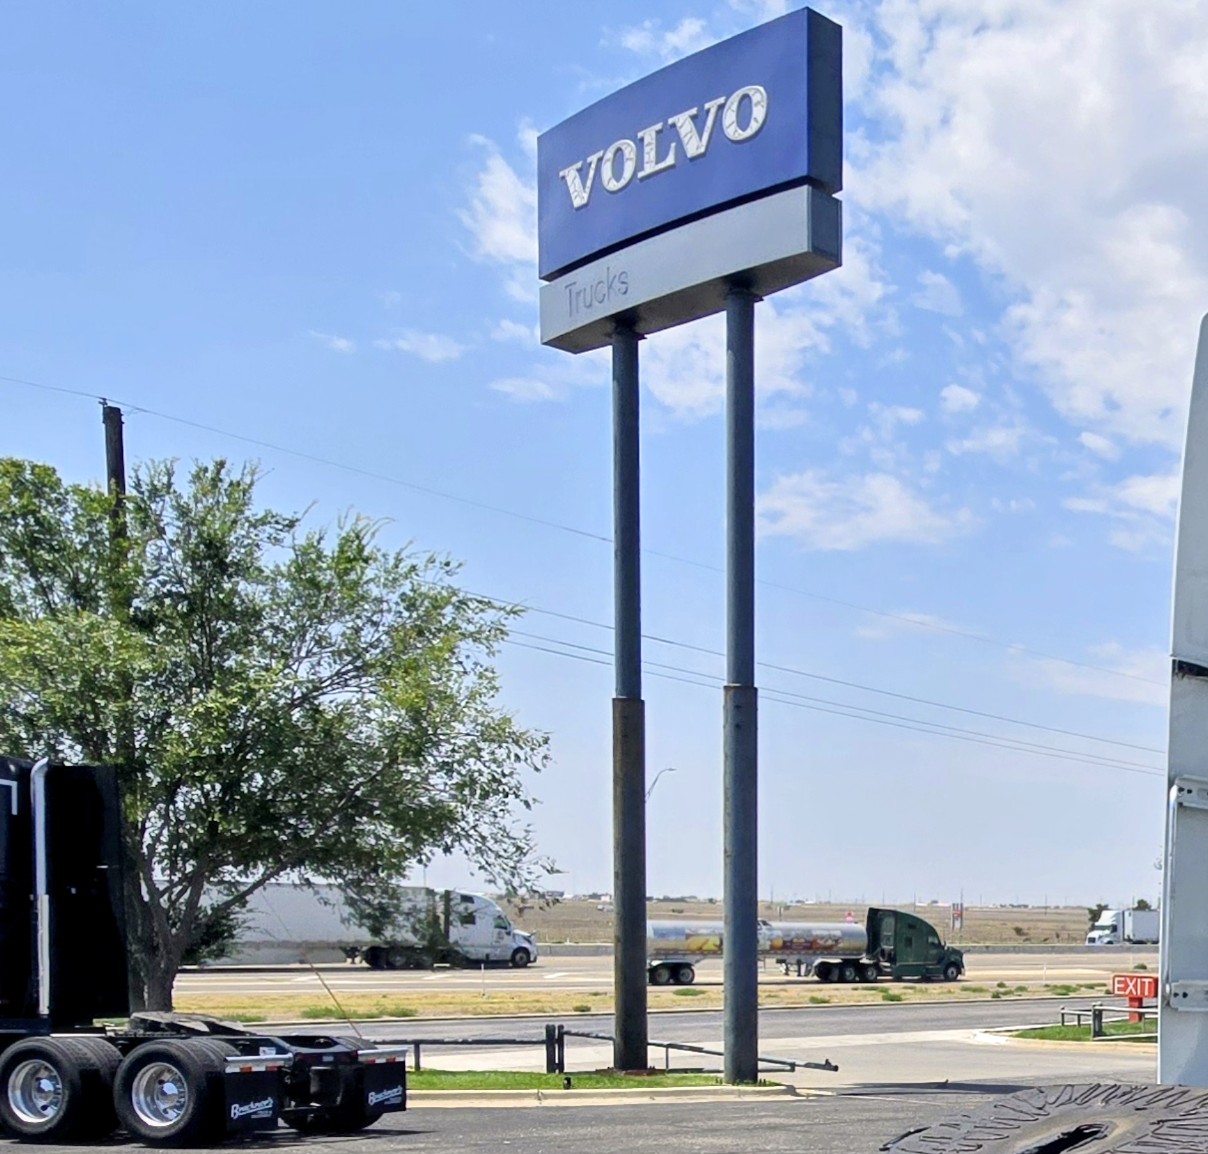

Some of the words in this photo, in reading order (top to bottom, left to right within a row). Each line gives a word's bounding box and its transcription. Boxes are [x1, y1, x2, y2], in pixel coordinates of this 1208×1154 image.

[559, 85, 768, 210] VOLVO
[564, 266, 630, 318] Trucks
[1114, 977, 1153, 996] EXIT
